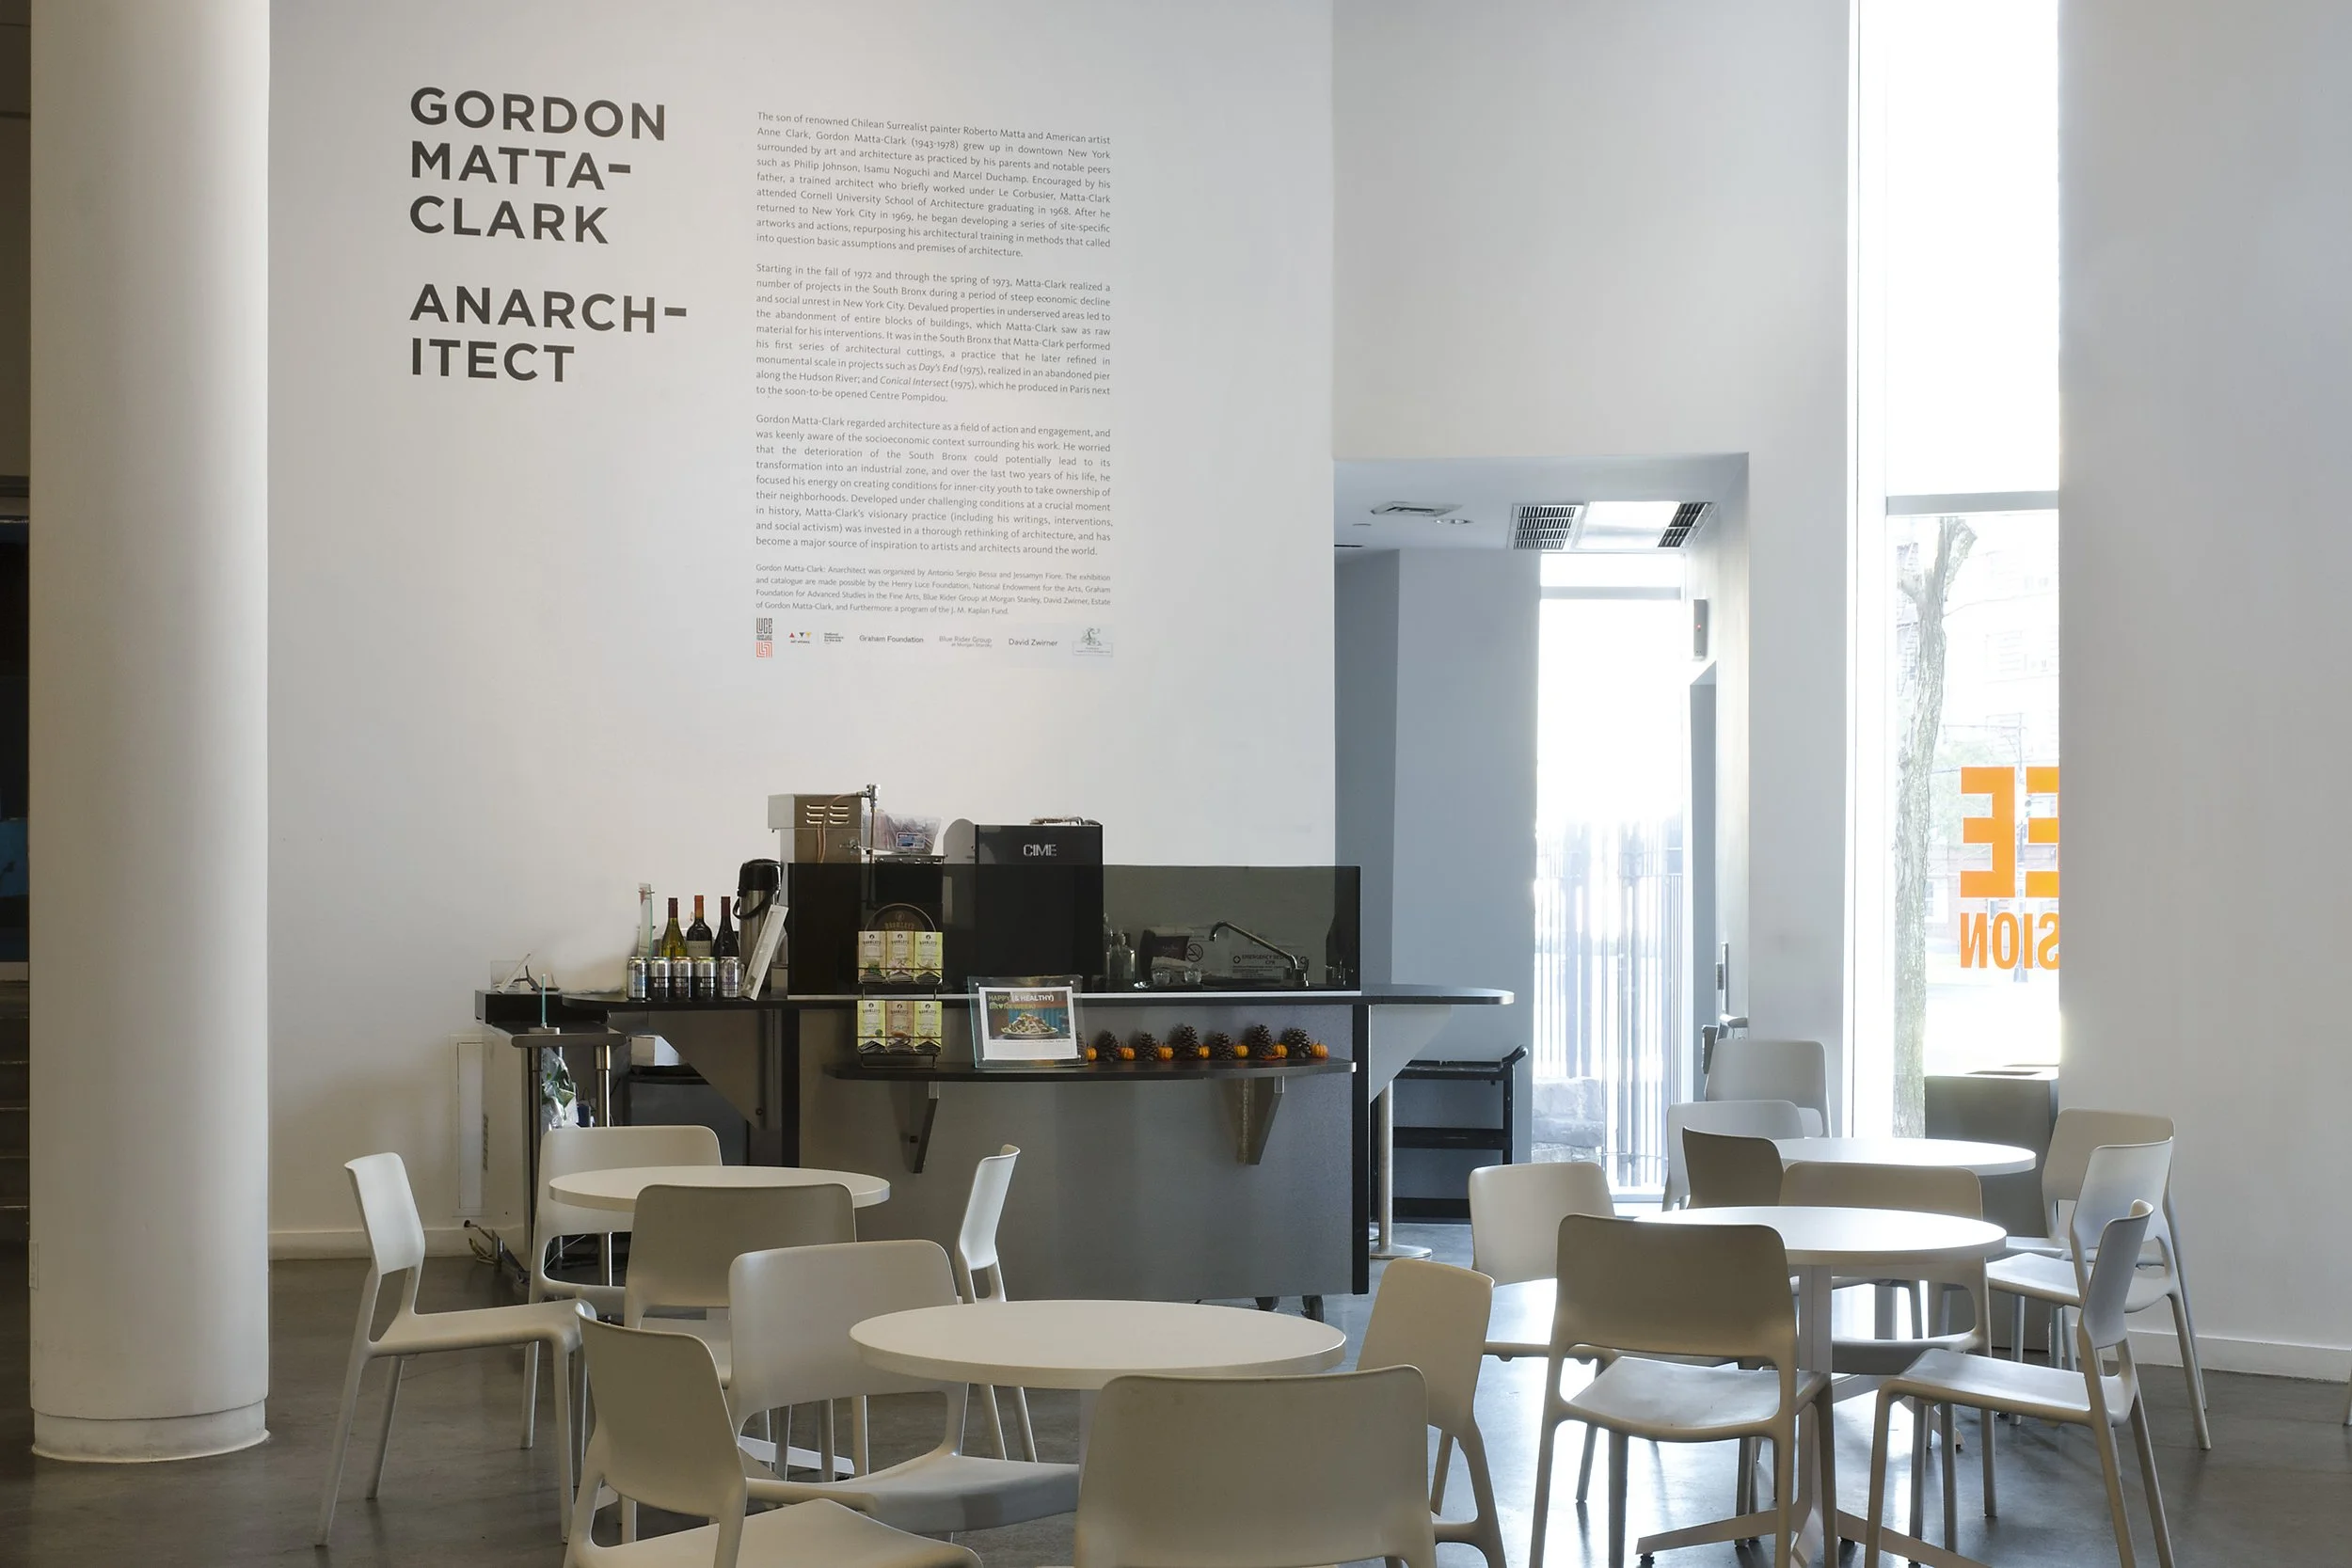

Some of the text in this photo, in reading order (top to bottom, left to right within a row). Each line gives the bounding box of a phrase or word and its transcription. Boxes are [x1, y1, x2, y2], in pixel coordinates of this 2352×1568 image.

[411, 87, 664, 140] GORDON
[757, 111, 1111, 145] The son of renowned Chilean Surrealist painter Roberto Matta and American artist
[756, 126, 781, 137] Anne
[816, 130, 850, 142] Gordon
[853, 133, 907, 146] Matta-Clark
[911, 136, 959, 150] (1943-1978)
[962, 142, 985, 152] grew
[989, 144, 1001, 154] up
[1005, 143, 1013, 152] in
[1017, 144, 1063, 156] downtown
[1067, 148, 1088, 158] New
[1091, 150, 1111, 159] York
[412, 141, 630, 190] MATTA-
[756, 143, 1111, 176] surrounded by art and architecture as practiced by his parents and notable peers
[756, 157, 777, 166] such
[780, 160, 791, 168] as
[793, 158, 819, 171] Philip
[864, 164, 890, 174] Isamu
[893, 166, 930, 179] Noguchi
[932, 168, 950, 179] and
[952, 169, 982, 181] Marcel
[1032, 174, 1082, 189] Encouraged
[1084, 178, 1095, 190] by
[1098, 179, 1111, 189] his
[789, 175, 795, 183] a
[799, 175, 832, 185] trained
[834, 177, 874, 188] architect
[878, 180, 898, 190] who
[900, 181, 930, 194] briefly
[932, 183, 965, 194] worked
[968, 185, 995, 196] under
[998, 187, 1009, 198] Le
[1059, 191, 1111, 203] Matta-Clark
[410, 196, 608, 244] CLARK
[755, 262, 792, 277] Starting
[795, 264, 803, 275] in
[806, 265, 821, 276] the
[824, 266, 838, 277] fall
[841, 267, 851, 277] of
[853, 270, 872, 280] 1972
[875, 270, 892, 279] and
[895, 270, 930, 284] through
[932, 273, 947, 283] the
[949, 274, 977, 287] spring
[979, 275, 991, 285] of
[1015, 277, 1067, 290] Matta-Clark
[1069, 281, 1103, 292] realized
[1104, 284, 1111, 293] a
[755, 278, 791, 289] number
[793, 279, 803, 290] of
[805, 281, 841, 293] projects
[843, 283, 852, 293] in
[854, 283, 870, 293] the
[872, 284, 898, 294] South
[900, 286, 927, 296] Bronx
[929, 287, 958, 301] during
[967, 290, 996, 301] period
[998, 291, 1009, 301] of
[1009, 293, 1035, 305] steep
[1036, 294, 1078, 305] economic
[1079, 295, 1111, 307] decline
[409, 284, 686, 333] ANARCH-
[413, 338, 574, 382] ITECT
[755, 413, 790, 424] Gordon
[791, 415, 845, 426] Matta-Clark
[846, 418, 886, 430] regarded
[887, 420, 941, 431] architecture
[960, 421, 979, 433] field
[980, 422, 991, 433] of
[991, 424, 1019, 434] action
[1020, 424, 1037, 435] and
[1094, 428, 1111, 437] and
[775, 429, 805, 442] keenly
[806, 433, 834, 442] aware
[835, 432, 846, 442] of
[848, 432, 863, 443] the
[865, 434, 930, 445] socioeconomic
[931, 437, 965, 447] context
[967, 438, 1021, 451] surrounding
[1022, 439, 1035, 450] his
[1062, 441, 1076, 451] He
[1077, 443, 1111, 452] worried
[756, 617, 772, 634] LUCE
[1009, 638, 1058, 647] David Zwirner
[1024, 844, 1057, 856] CIME
